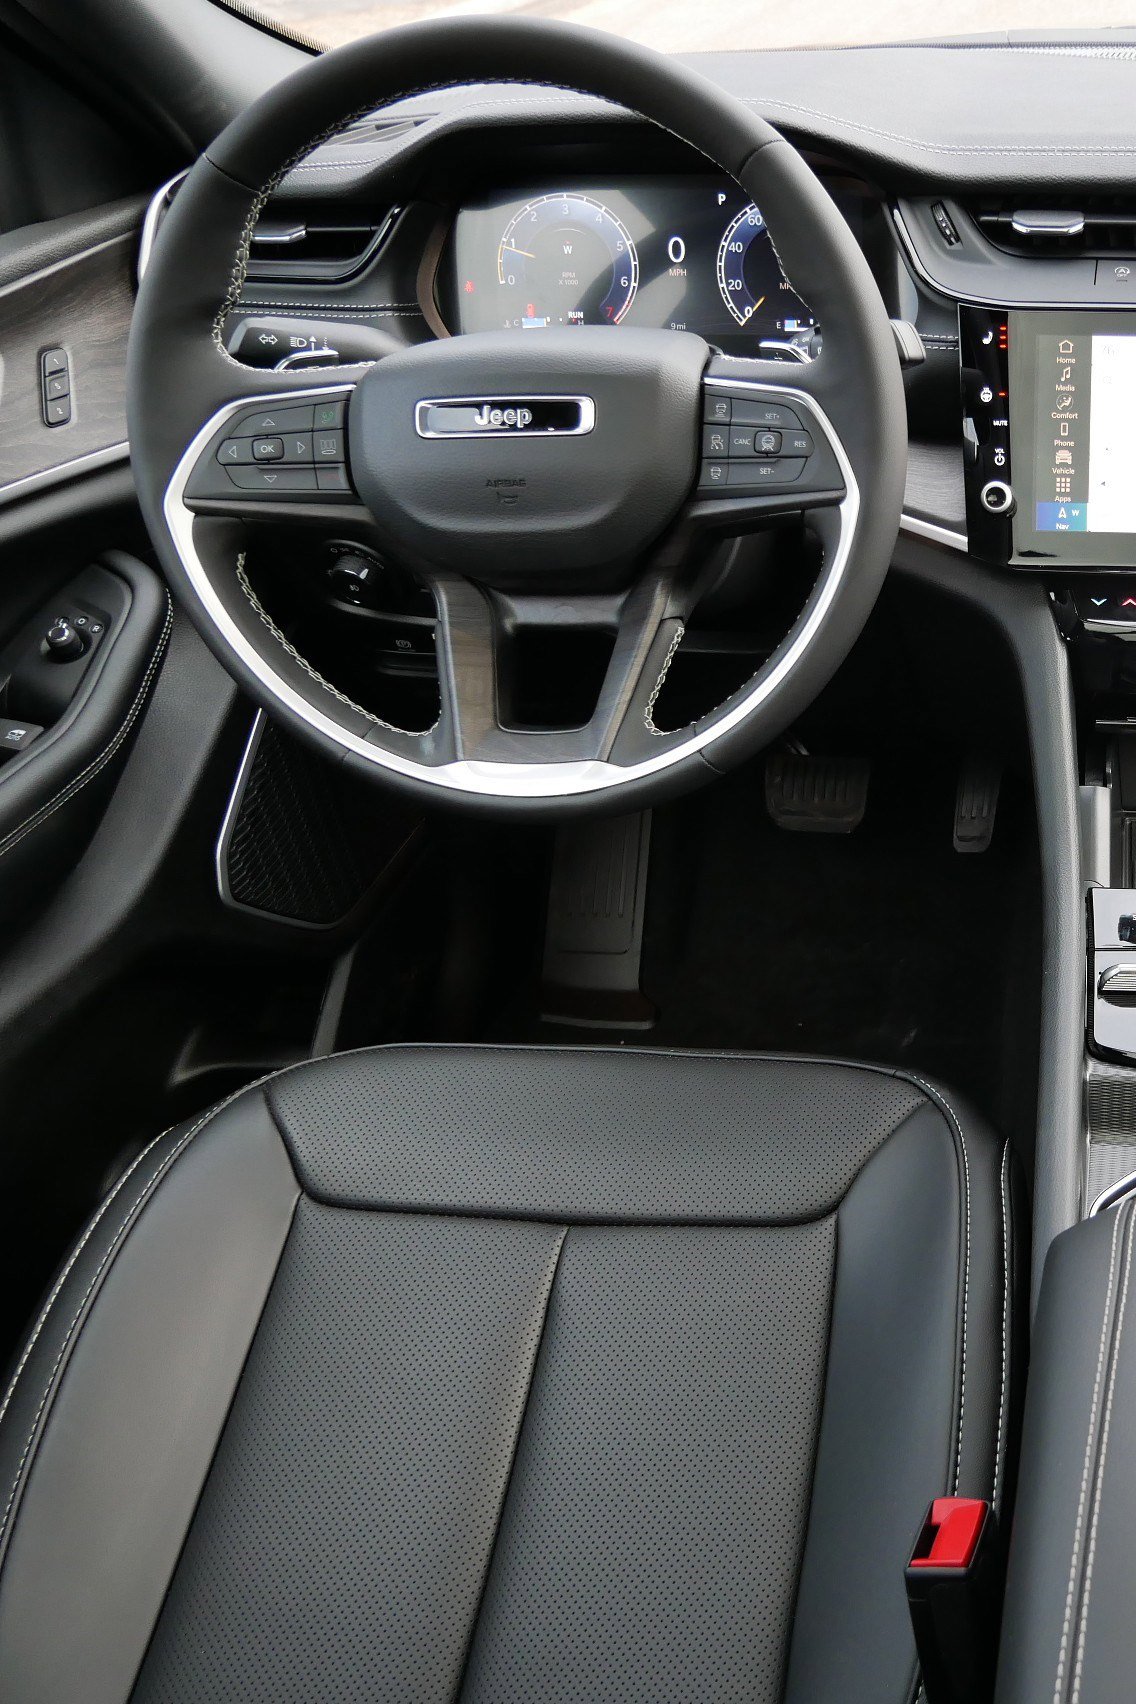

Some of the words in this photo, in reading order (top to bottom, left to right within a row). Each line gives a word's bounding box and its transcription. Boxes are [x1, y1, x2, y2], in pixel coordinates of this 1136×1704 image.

[718, 194, 726, 205] P
[562, 206, 569, 215] 3
[531, 212, 538, 221] 2
[596, 214, 603, 223] 4
[748, 215, 763, 226] 60
[510, 238, 516, 248] 1
[616, 241, 624, 251] 5
[728, 242, 743, 253] 40
[563, 245, 573, 254] W
[668, 237, 686, 263] 0
[669, 269, 687, 277] MPH
[508, 275, 516, 285] 0
[621, 277, 629, 286] 6
[728, 280, 743, 291] 20
[568, 311, 584, 319] RUN
[606, 307, 615, 318] 7
[744, 306, 753, 317] 0
[776, 322, 781, 330] E
[1056, 384, 1075, 392] Media
[56, 407, 64, 415] 2
[474, 406, 533, 429] Jeep
[260, 445, 275, 453] OK
[486, 479, 527, 487] AIRBAG
[1054, 496, 1072, 504] Apps
[1072, 509, 1080, 517] W
